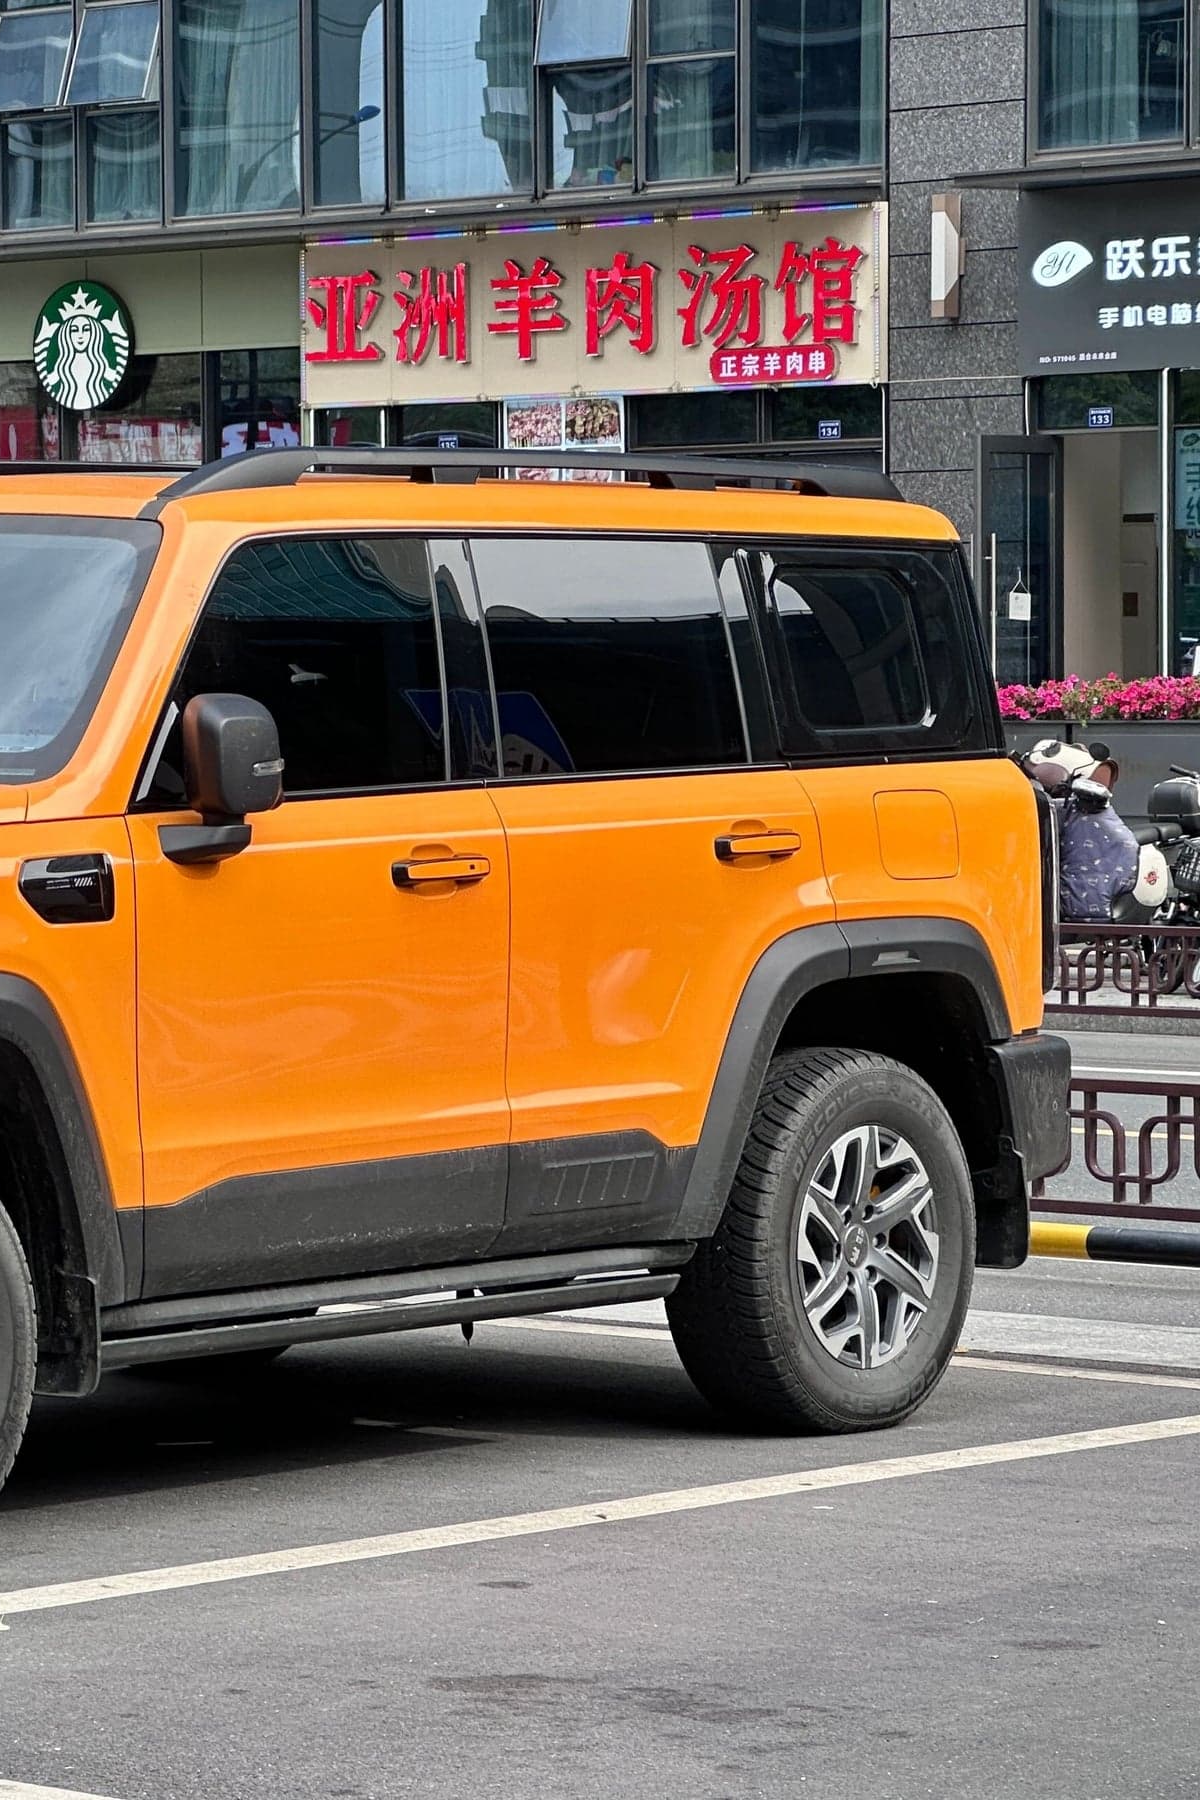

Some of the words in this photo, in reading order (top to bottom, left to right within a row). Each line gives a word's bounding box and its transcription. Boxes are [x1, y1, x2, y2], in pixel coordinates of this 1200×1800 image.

[1106, 235, 1200, 281] 跃乐
[304, 237, 863, 364] 亚洲羊肉汤馆
[719, 350, 826, 378] 正宗羊肉串
[821, 427, 838, 437] 134
[1091, 414, 1110, 425] 133
